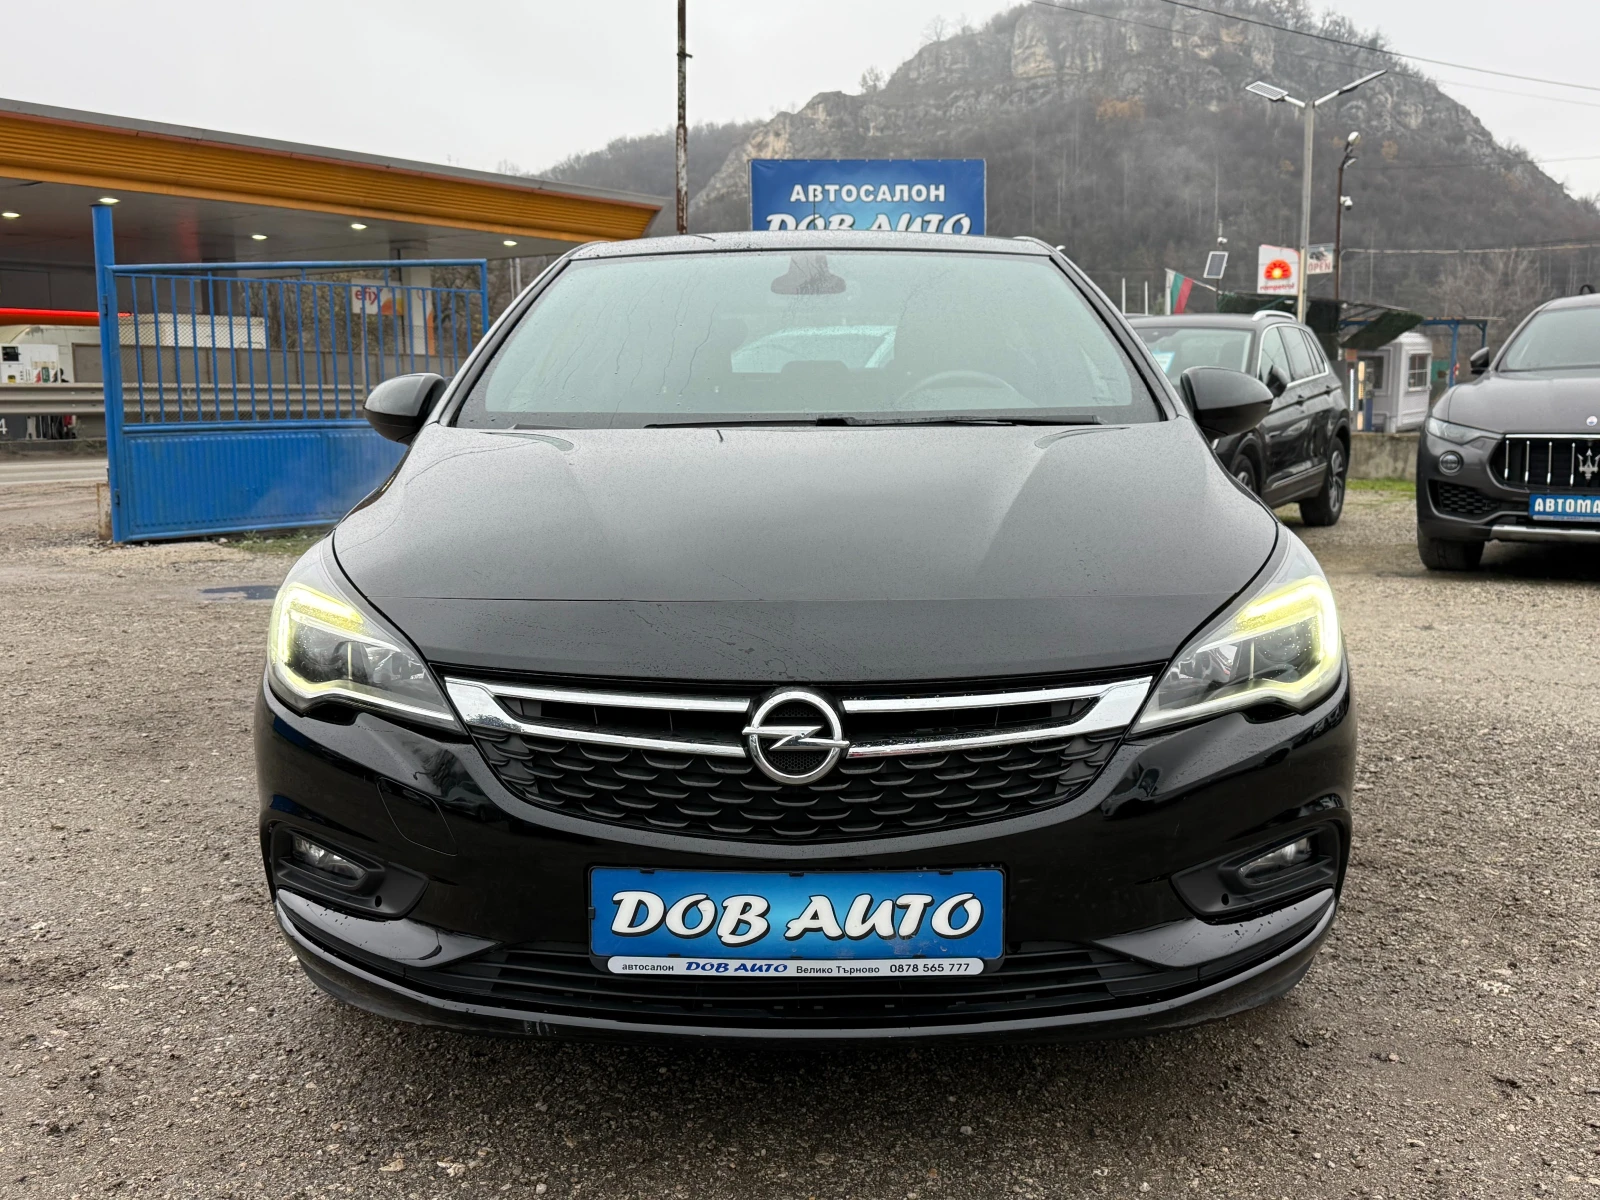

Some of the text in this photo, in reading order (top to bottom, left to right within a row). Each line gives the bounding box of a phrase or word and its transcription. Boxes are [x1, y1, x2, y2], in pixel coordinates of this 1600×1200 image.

[789, 183, 945, 203] АВТОСАЛОН
[867, 213, 972, 235] AUTO
[1308, 262, 1331, 273] OPEN
[611, 890, 984, 947] DOB AUTO
[622, 961, 970, 975] автосалон DOB AUTO Велико Търново 0878 565 777
